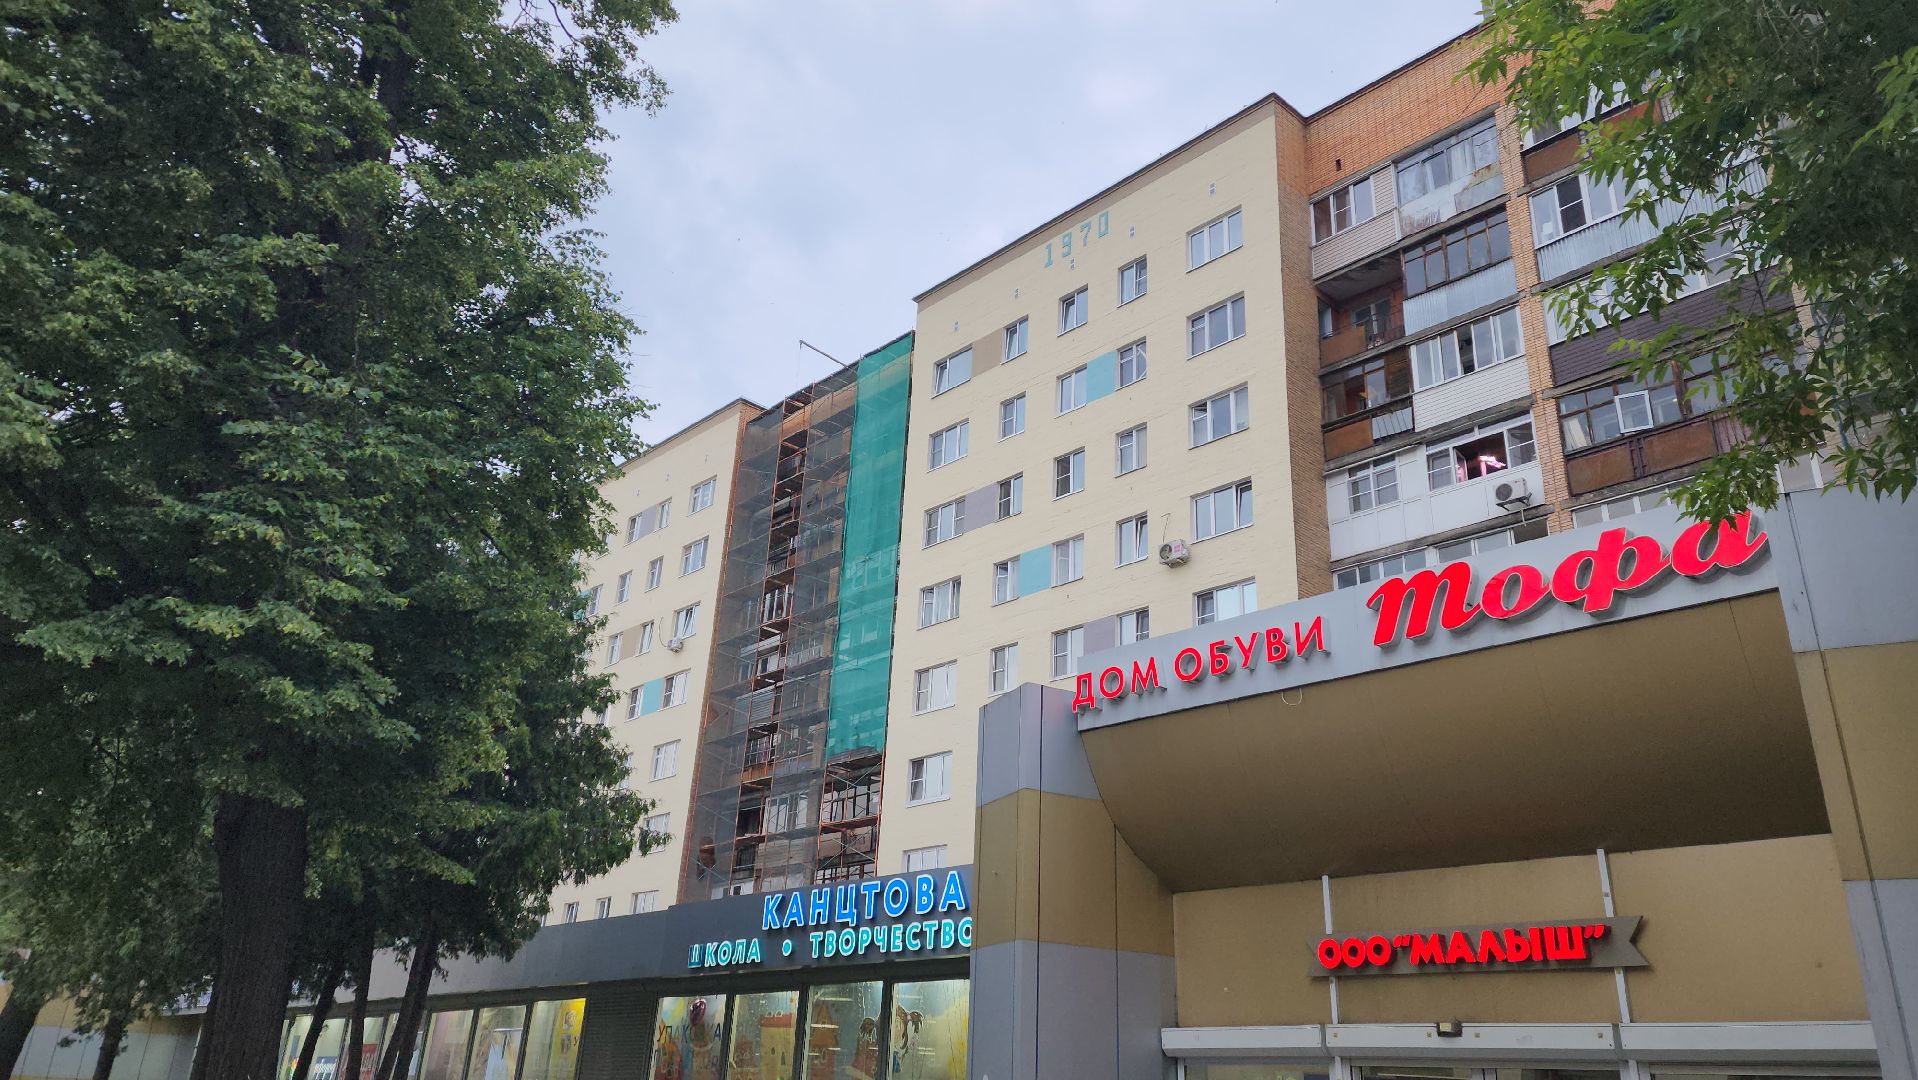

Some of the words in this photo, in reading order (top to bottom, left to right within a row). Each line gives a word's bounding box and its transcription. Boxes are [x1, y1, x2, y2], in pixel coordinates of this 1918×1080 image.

[1044, 210, 1109, 269] 1970
[1072, 656, 1160, 713] ДОМ
[1174, 615, 1325, 682] ОБУВИ
[687, 937, 761, 968] ШКОЛА
[810, 916, 973, 958] ТВОРЧЕСТВО
[1317, 934, 1392, 969] ООО
